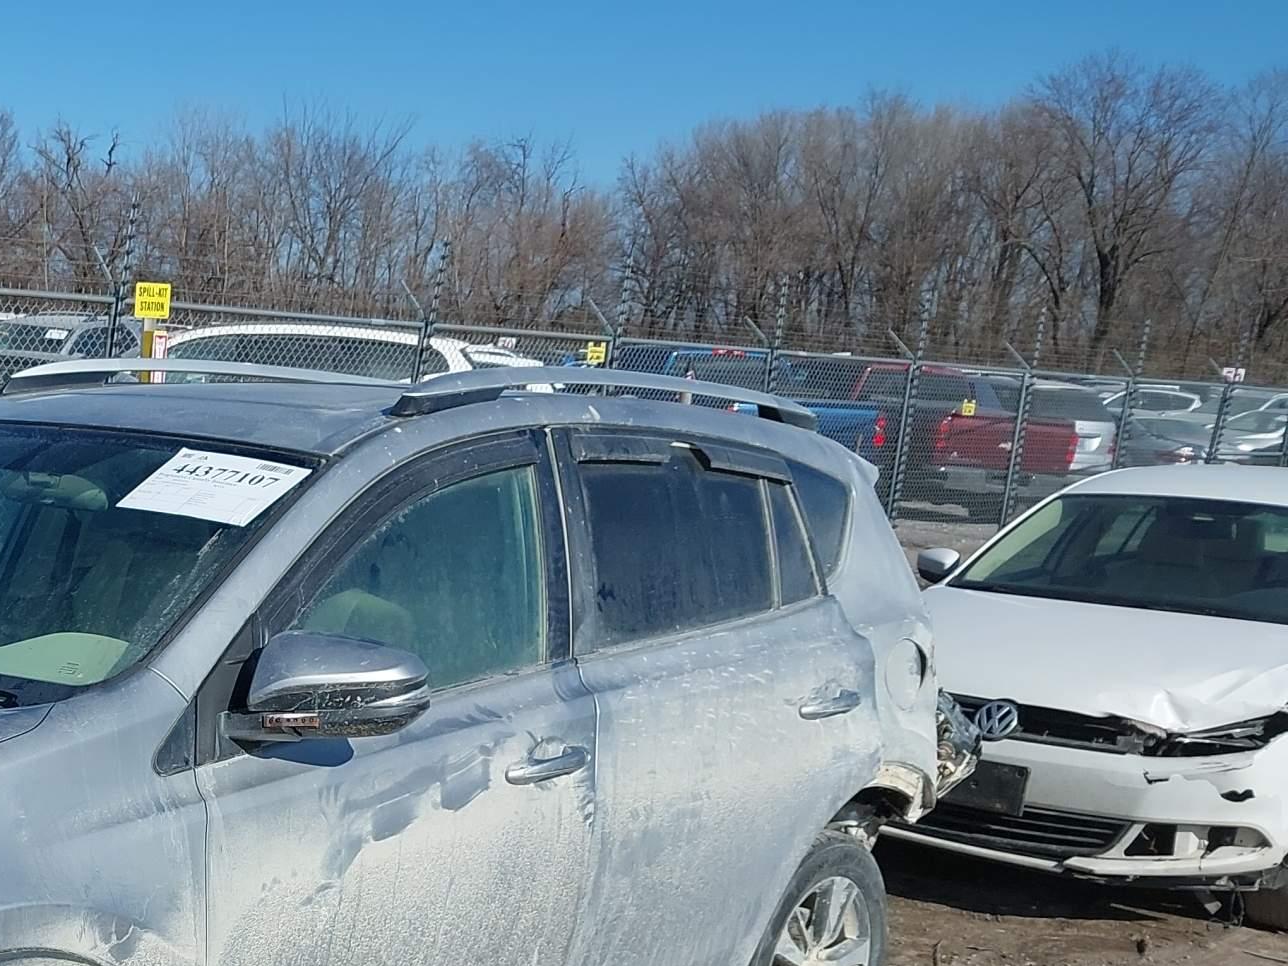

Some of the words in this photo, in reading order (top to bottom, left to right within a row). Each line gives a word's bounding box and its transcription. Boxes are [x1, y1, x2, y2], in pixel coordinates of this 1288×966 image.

[138, 286, 169, 298] SPILL-KIT
[139, 301, 166, 312] STATION
[172, 463, 281, 489] 44377107
